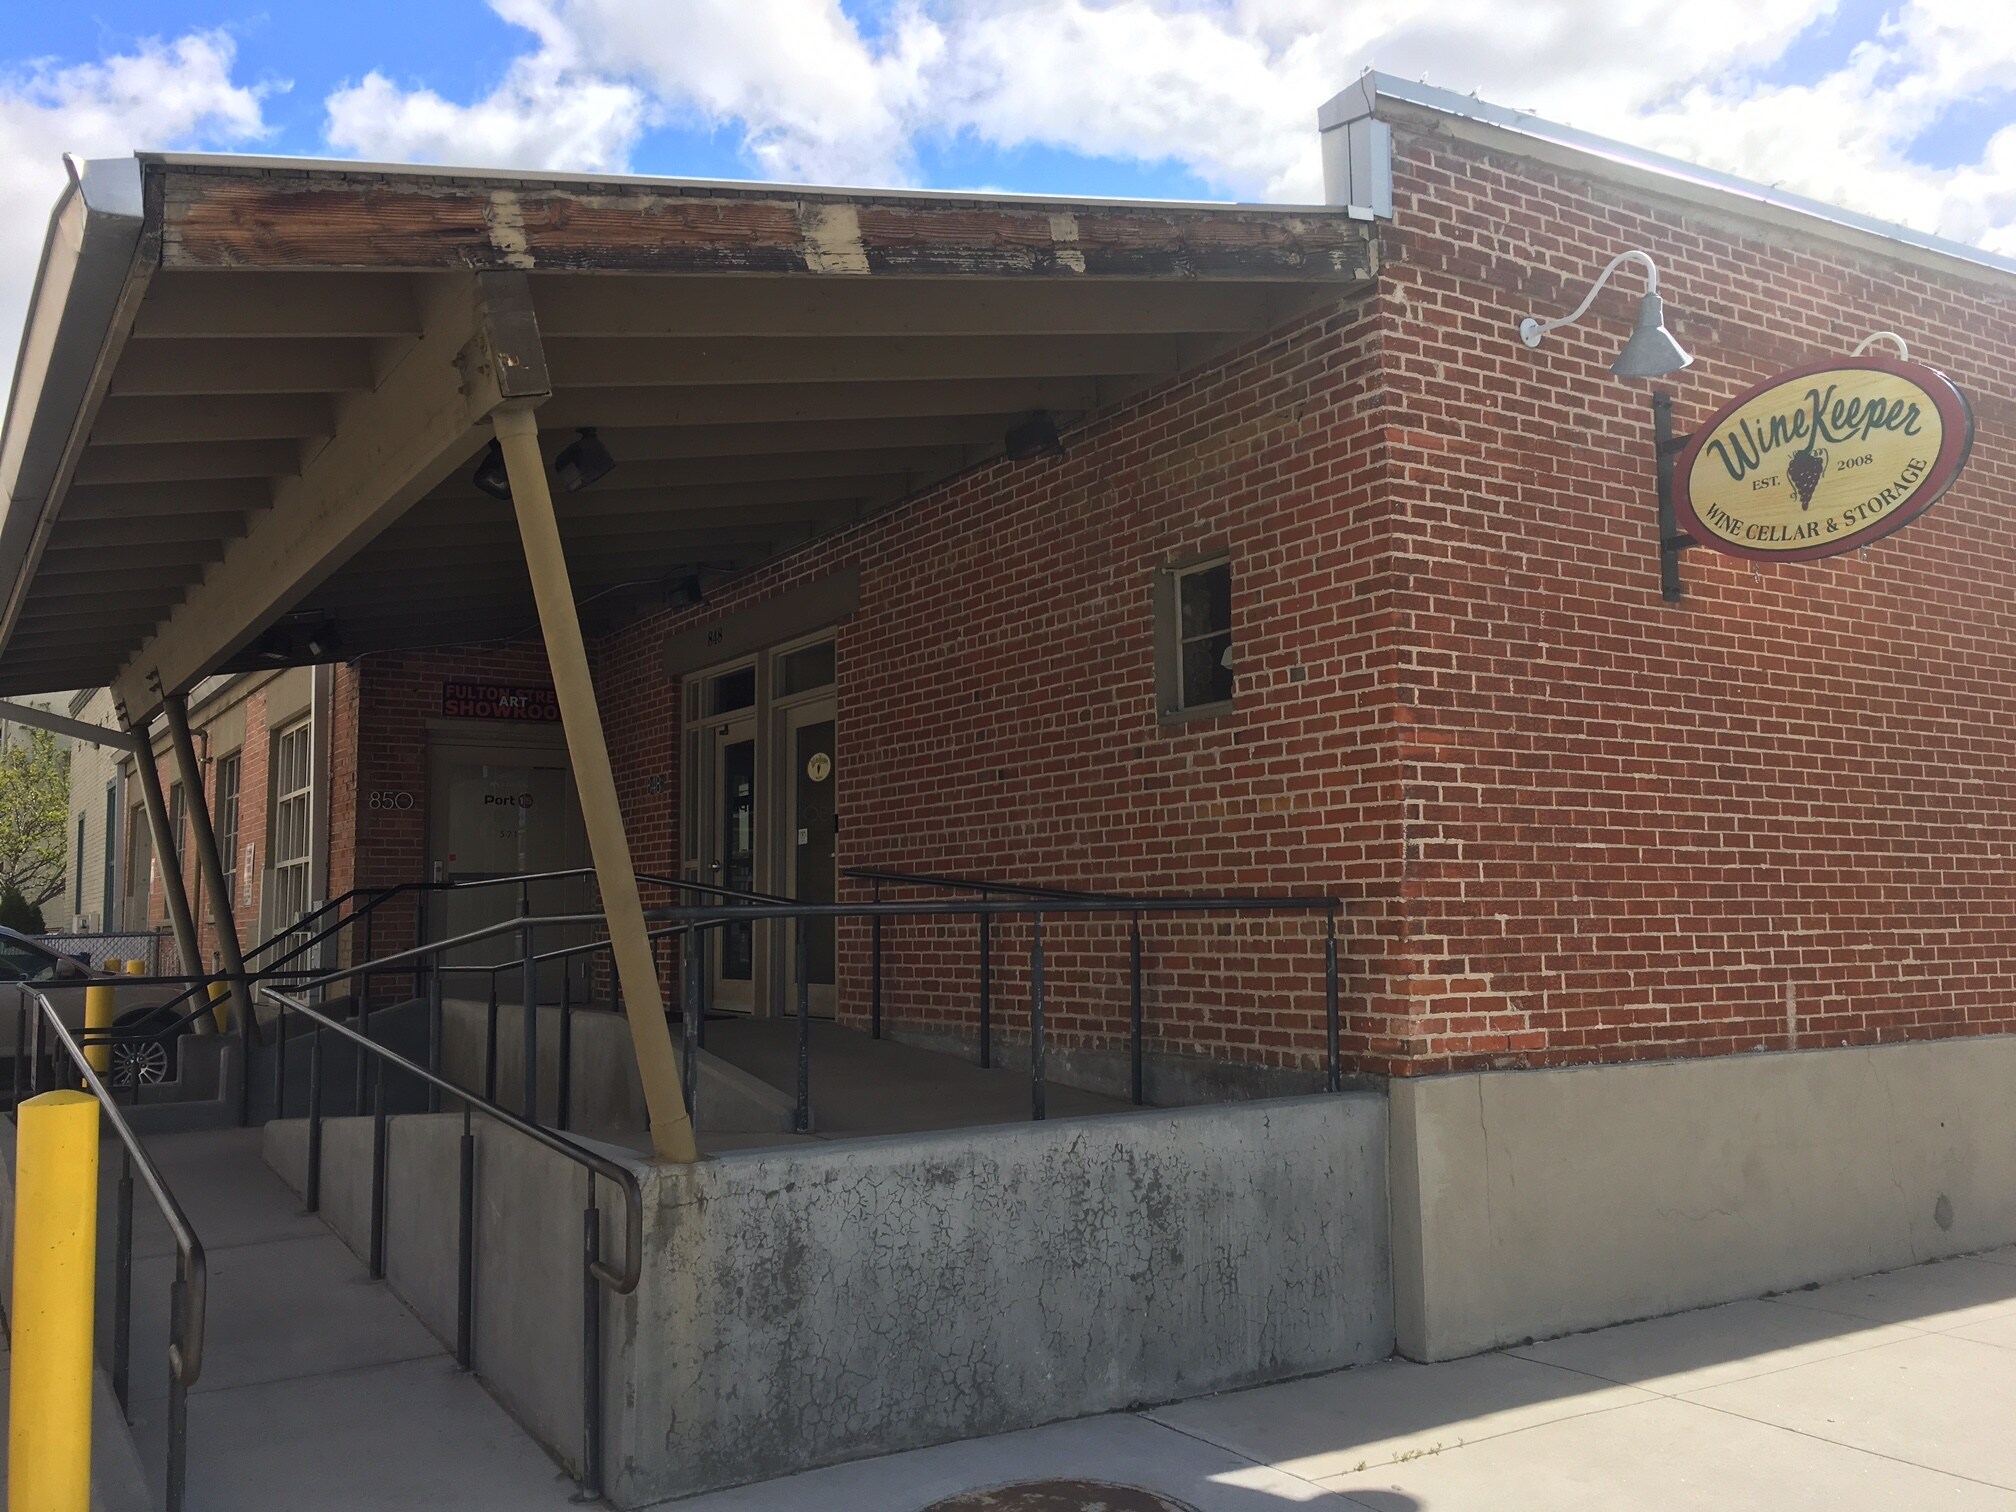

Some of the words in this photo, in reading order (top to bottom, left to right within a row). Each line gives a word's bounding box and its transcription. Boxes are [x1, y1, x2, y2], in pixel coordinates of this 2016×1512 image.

[1706, 384, 1921, 481] WineKeeper
[1752, 475, 1780, 491] EST.
[1837, 454, 1873, 471] 2008
[1705, 502, 1744, 536] WINE
[1746, 520, 1819, 542] CELLAR
[1826, 517, 1840, 533] &
[1843, 457, 1927, 528] STORAGE
[707, 627, 723, 647] 848
[446, 684, 510, 700] FULTON
[515, 688, 555, 704] STRE
[499, 696, 528, 708] ART
[446, 700, 559, 720] SHOWROO
[369, 791, 414, 810] 850
[484, 795, 515, 806] Port
